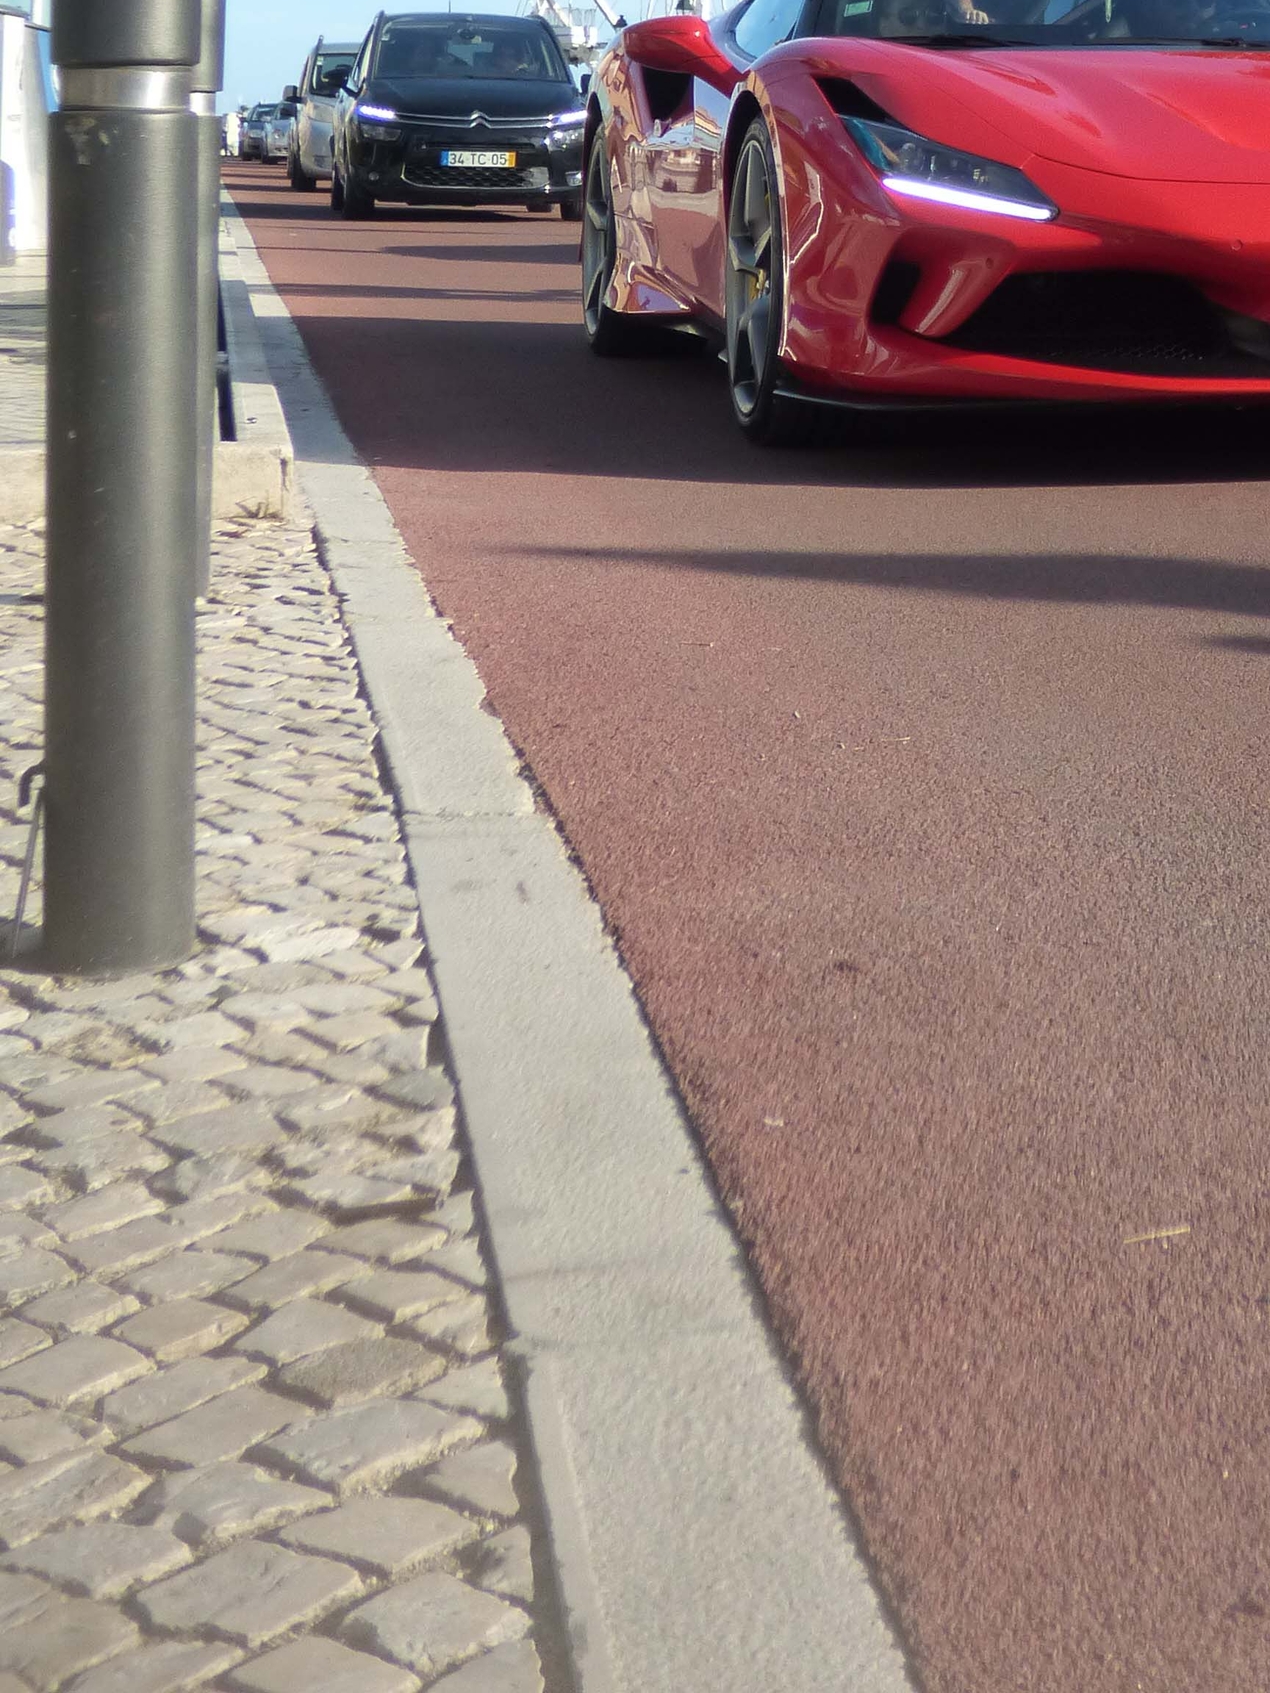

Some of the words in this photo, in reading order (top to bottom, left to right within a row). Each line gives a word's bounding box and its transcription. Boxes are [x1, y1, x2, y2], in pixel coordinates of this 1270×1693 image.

[449, 153, 464, 165] 34
[470, 153, 487, 165] TC
[491, 153, 507, 165] 05
